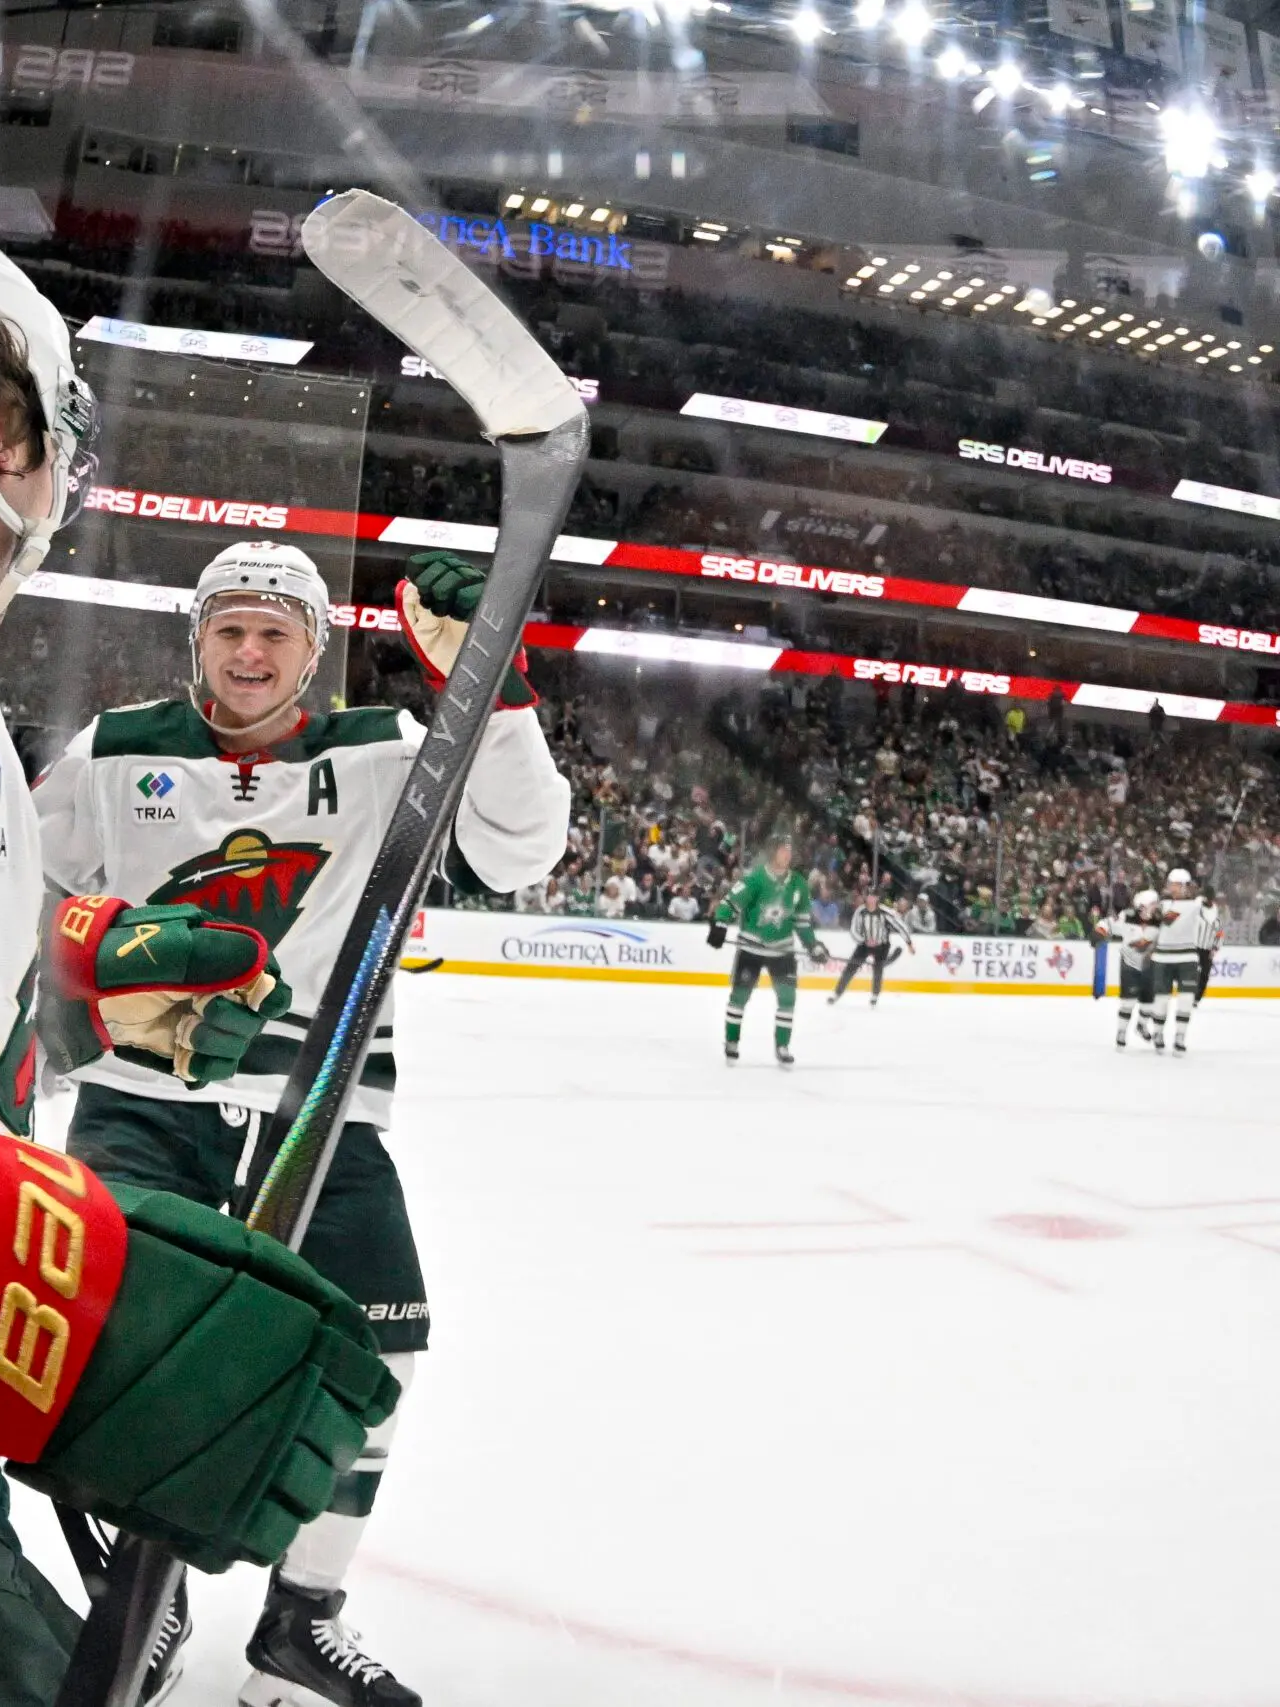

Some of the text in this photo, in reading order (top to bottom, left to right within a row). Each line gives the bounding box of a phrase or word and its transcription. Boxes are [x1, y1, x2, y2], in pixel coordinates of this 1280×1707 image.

[528, 222, 633, 271] Bank
[401, 355, 447, 380] SR
[958, 438, 1113, 484] SRS DELIVERS
[83, 487, 289, 529] SRS DELIVERS
[238, 560, 284, 570] BAUER
[700, 554, 885, 597] SRS DELIVERS
[327, 604, 357, 627] RS
[1198, 624, 1239, 647] SRS
[902, 664, 1011, 695] DELIERS
[307, 758, 339, 816] A
[134, 807, 176, 820] TRIA
[618, 943, 673, 966] Bank
[973, 941, 1039, 958] BEST IN
[972, 959, 1038, 979] TEXAS
[359, 1302, 430, 1321] AUER
